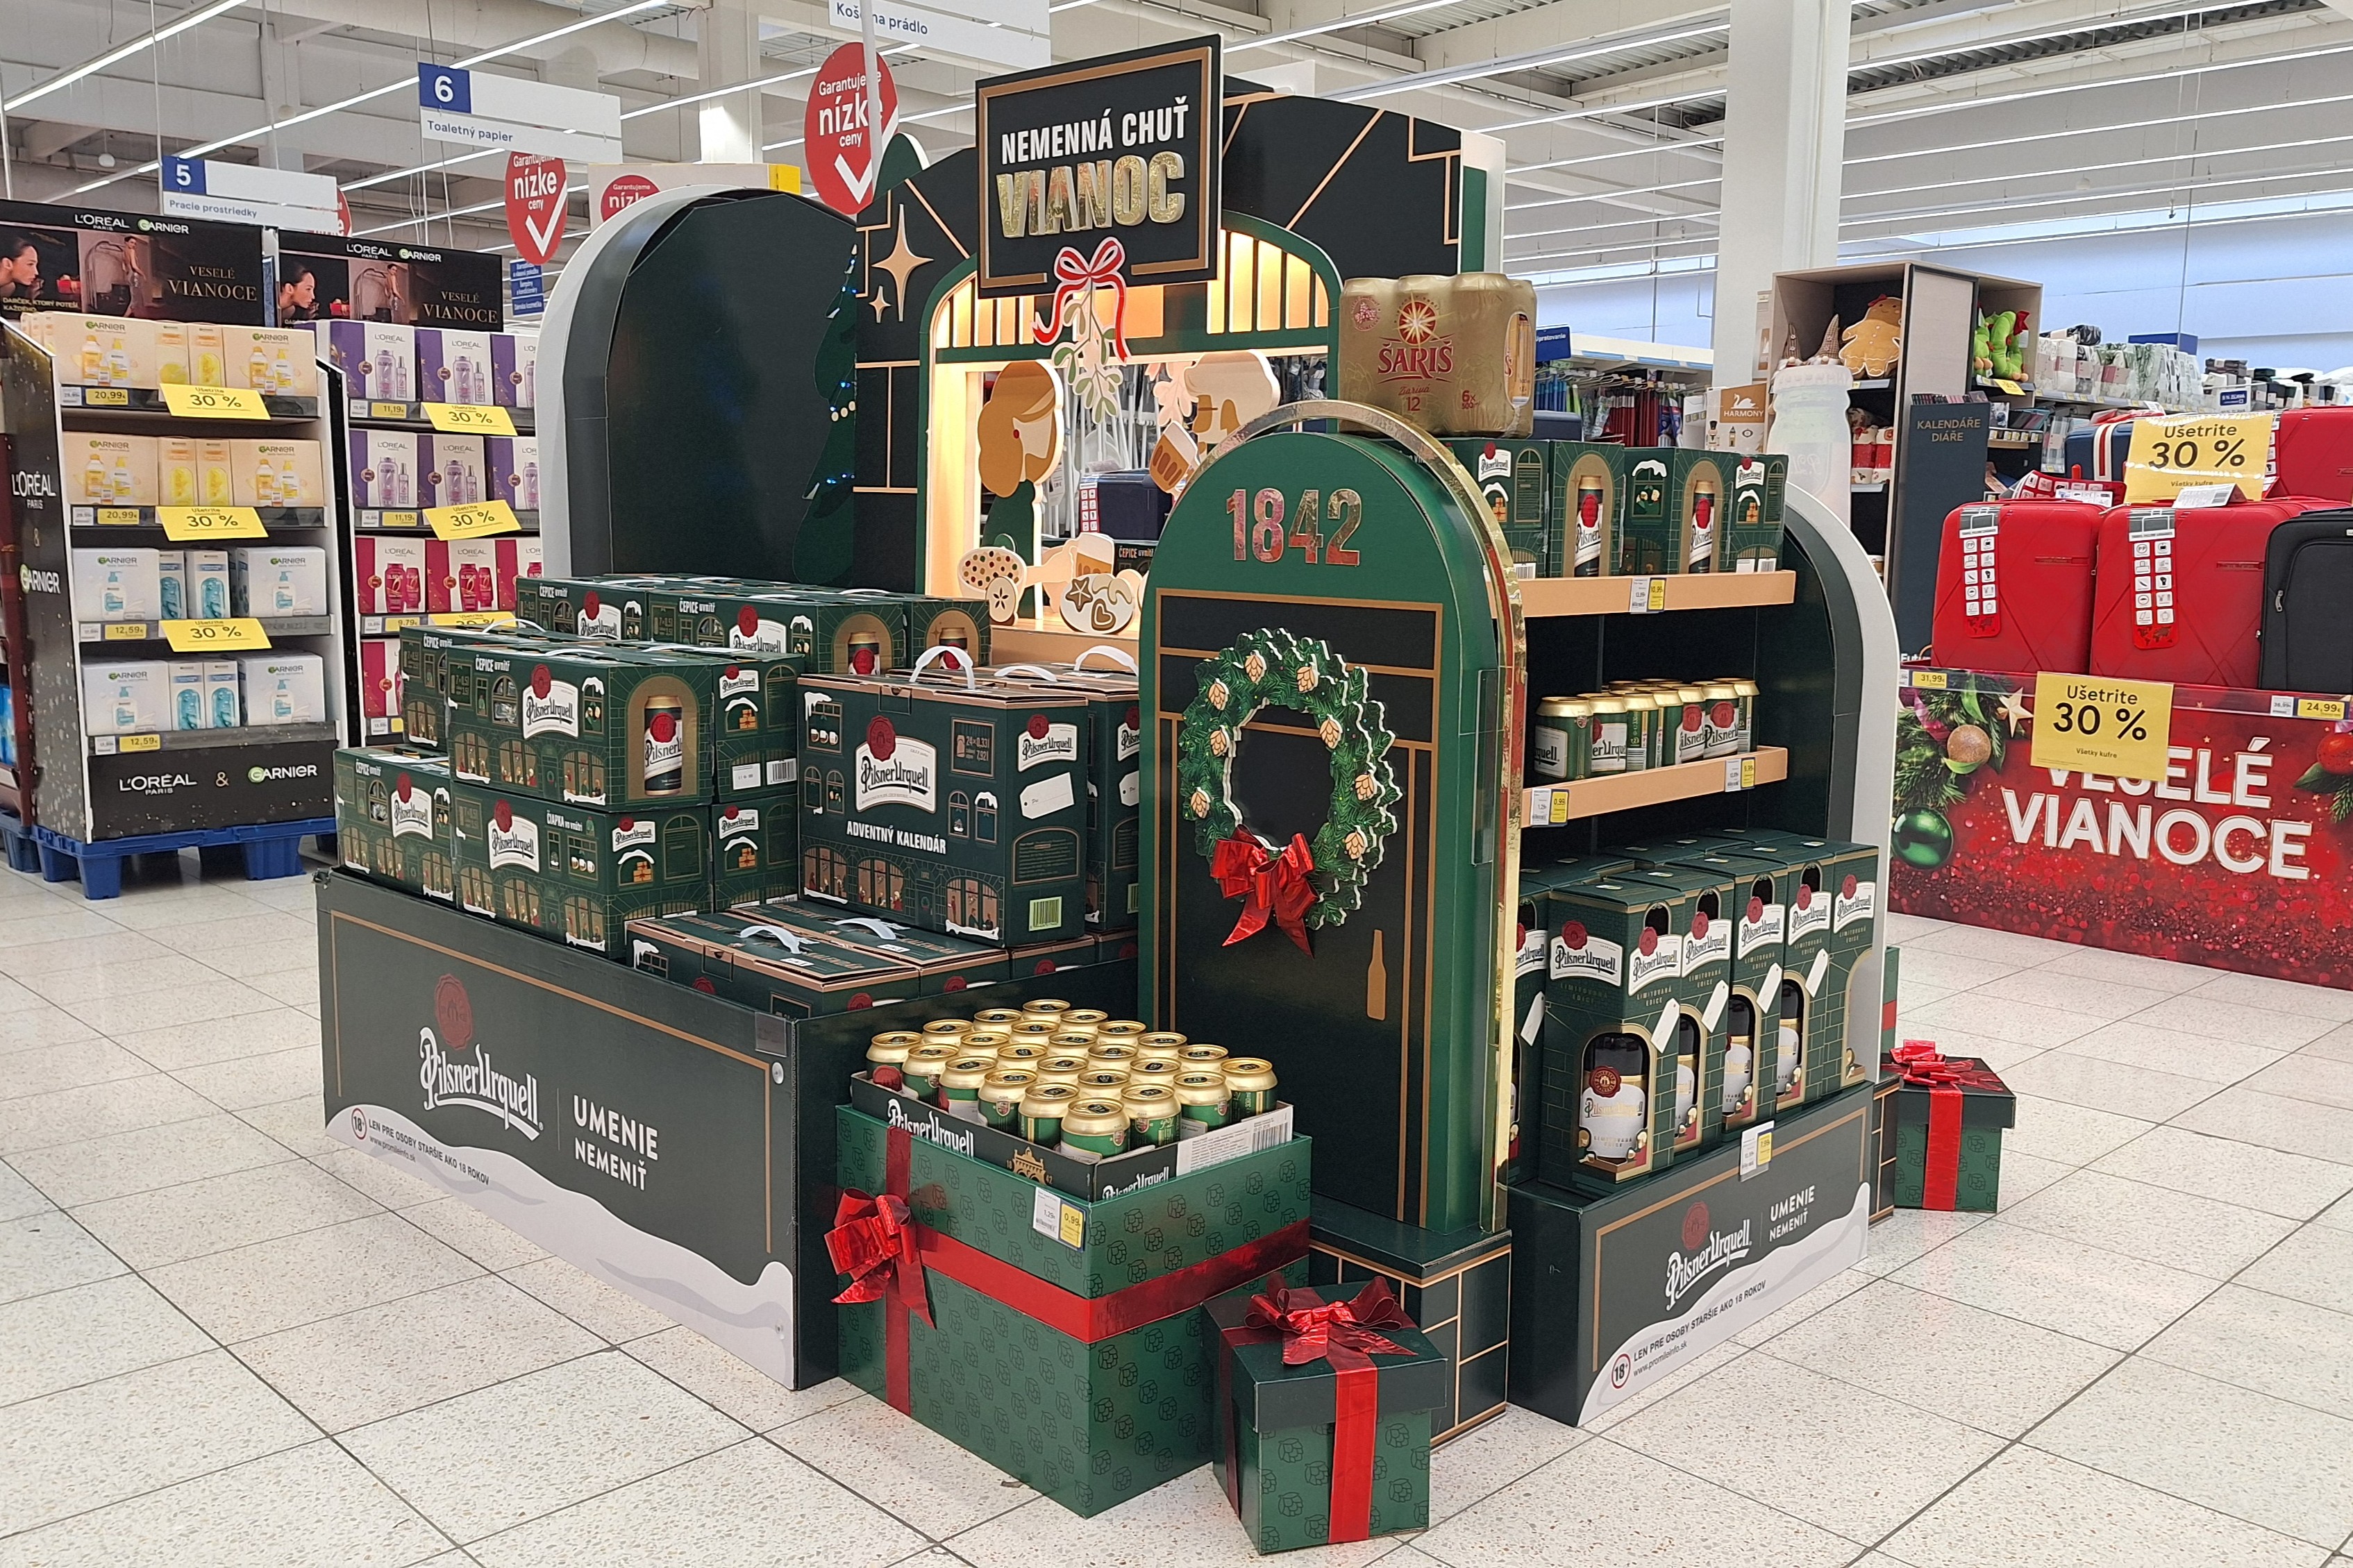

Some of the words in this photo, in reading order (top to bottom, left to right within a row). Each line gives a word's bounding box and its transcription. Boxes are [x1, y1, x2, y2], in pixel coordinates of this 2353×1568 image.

[837, 3, 860, 19] Koš
[889, 15, 928, 35] prádlo
[434, 76, 453, 103] 6
[427, 120, 475, 137] Toaletný
[478, 129, 513, 142] papier
[839, 132, 862, 148] ceny
[1001, 108, 1114, 165] NEMENNÁ
[1121, 95, 1189, 148] CHUŤ
[176, 165, 191, 186] 5
[514, 167, 558, 200] nízke
[528, 198, 544, 212] ceny
[996, 151, 1185, 238] VIANOC
[169, 200, 201, 211] Pracie
[203, 204, 258, 219] prostriedky
[74, 214, 130, 229] L'ORÉAL
[137, 219, 190, 235] GARNIER
[346, 243, 392, 257] L'ORÉAL
[399, 247, 442, 262] GARNIER
[190, 265, 235, 279] VESELÉ
[168, 279, 258, 302] VIANOCE
[440, 291, 480, 304] VESELÉ
[422, 303, 499, 324] VIANOCE
[85, 321, 126, 332] GARNIER
[252, 332, 290, 342] GARNIER
[1378, 339, 1454, 379] ŠARIŠ
[190, 394, 215, 407] 30
[222, 396, 242, 408] %
[1407, 396, 1421, 412] 12
[448, 412, 471, 422] 30
[476, 412, 493, 423] %
[1916, 416, 1982, 430] KALENDÁŘE
[1931, 430, 1964, 442] DIÁŘE
[2163, 423, 2238, 439] Ušetrite
[89, 440, 130, 450] GARNIER
[258, 445, 294, 455] GARNIER
[2147, 441, 2199, 471] 30
[2213, 438, 2246, 469] %
[11, 471, 57, 498] L'ORÉAL
[186, 516, 212, 528] 30
[219, 515, 239, 527] %
[450, 514, 473, 528] 30
[478, 510, 495, 523] %
[1226, 487, 1362, 565] 1842
[98, 556, 137, 565] GARNIER
[269, 556, 306, 565] GARNIER
[1119, 546, 1137, 558] ČEPICE
[20, 564, 61, 594] GARNIER
[539, 583, 555, 598] ČEPICE
[679, 598, 698, 614] ČEPICE
[190, 627, 216, 639] 30
[222, 625, 242, 637] %
[423, 634, 439, 649] ČEPICE
[268, 665, 304, 675] GARNIER
[475, 655, 494, 672] ČEPICE
[108, 671, 149, 680] GARNIER
[2066, 684, 2138, 707] Ušetrite
[526, 695, 551, 725] Pilsner
[549, 697, 575, 724] Urquell
[2052, 702, 2102, 736] 30
[2115, 709, 2147, 741] %
[1680, 732, 1703, 748] ilsner
[1705, 724, 1736, 749] Pilsner
[645, 739, 678, 767] Pilsner
[1022, 738, 1050, 761] Pilsner
[1047, 736, 1073, 755] Urquell
[2075, 747, 2098, 759] Všetky
[2098, 750, 2118, 759] kufre
[119, 773, 197, 793] L'ORÉAL
[215, 771, 230, 788] &
[248, 764, 318, 783] GARNIER
[861, 755, 898, 794] Pilsner
[894, 757, 929, 793] Urquell
[144, 787, 174, 796] PARIS
[546, 809, 564, 827] ČIAPKA
[492, 828, 514, 857] Pilsner
[512, 831, 535, 859] Urquell
[846, 820, 894, 844] ADVENTNÝ
[896, 833, 946, 854] KALENDÁR
[2002, 789, 2313, 880] VIANOCE
[1555, 945, 1588, 969] Pilsner
[1584, 948, 1618, 973] Urquell
[1685, 940, 1709, 965] Pilsner
[1706, 934, 1727, 953] Urquell
[1632, 956, 1658, 983] Pilsner
[1655, 950, 1678, 970] Urquell
[419, 1026, 480, 1111] Pilsner
[474, 1043, 539, 1130] Urquell
[573, 1094, 659, 1161] UMENIE
[368, 1118, 381, 1133] LEN
[382, 1124, 395, 1139] PRE
[395, 1130, 417, 1149] OSOBY
[417, 1140, 444, 1162] STARŠIE
[444, 1154, 458, 1168] AKO
[458, 1162, 467, 1174] 18
[467, 1165, 490, 1186] ROKOV
[574, 1137, 647, 1191] NEMENIŤ
[1770, 1185, 1816, 1222] UMENIE
[1768, 1207, 1809, 1242] NEMENIŤ
[1665, 1250, 1713, 1312] Pilsner
[1709, 1217, 1751, 1267] Urquell
[1633, 1345, 1648, 1363] LEN
[1649, 1336, 1665, 1354] PRE
[1665, 1323, 1690, 1345] OSOBY
[1690, 1306, 1719, 1331] STARŠIE
[1719, 1297, 1734, 1316] AKO
[1734, 1293, 1743, 1305] 18
[1743, 1279, 1767, 1301] ROKOV
